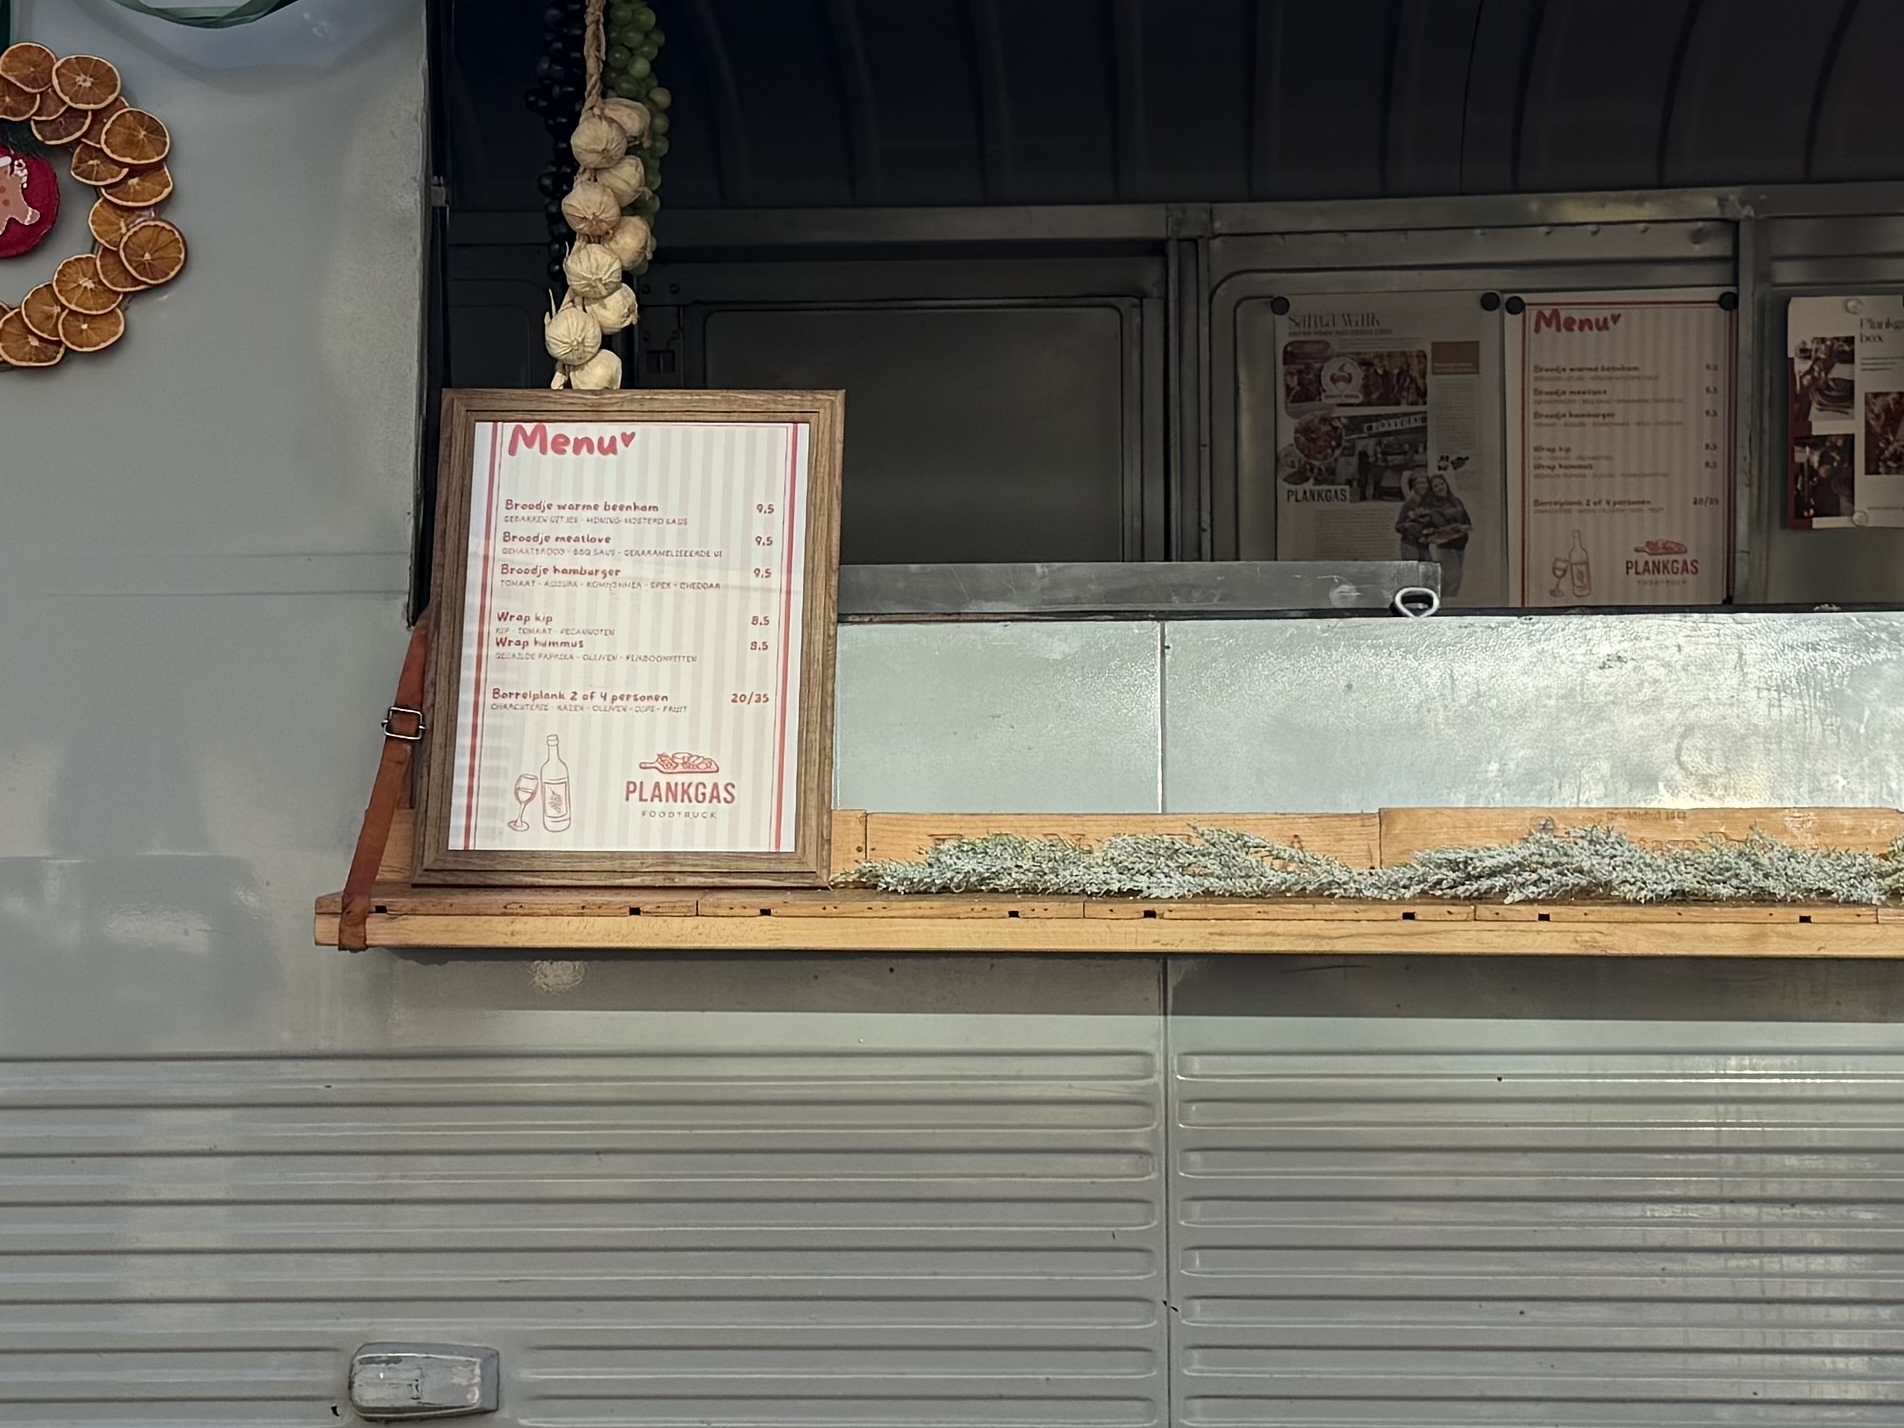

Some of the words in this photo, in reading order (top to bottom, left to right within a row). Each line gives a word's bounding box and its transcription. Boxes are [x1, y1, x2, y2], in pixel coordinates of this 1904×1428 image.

[1534, 308, 1609, 334] Menu
[508, 423, 618, 457] Menu
[1287, 488, 1348, 503] PLANKGAS
[505, 499, 553, 514] Broodje
[556, 501, 599, 512] warme
[604, 500, 659, 513] beenham
[502, 530, 551, 545] Broodje
[555, 532, 612, 544] meatlove
[501, 563, 549, 579] Broodje
[553, 565, 622, 580] hamburger
[1626, 558, 1700, 576] PLANKGAS
[497, 611, 531, 625] Wrap
[535, 612, 554, 625] kip
[495, 637, 529, 650] Wrap
[534, 637, 584, 649] hummus
[492, 687, 565, 703] Borrelplank
[570, 691, 579, 702] 2
[582, 690, 595, 702] of
[599, 691, 608, 702] 4
[611, 693, 669, 705] personen
[730, 691, 770, 706] 20/35
[625, 780, 736, 805] PLANKGAS
